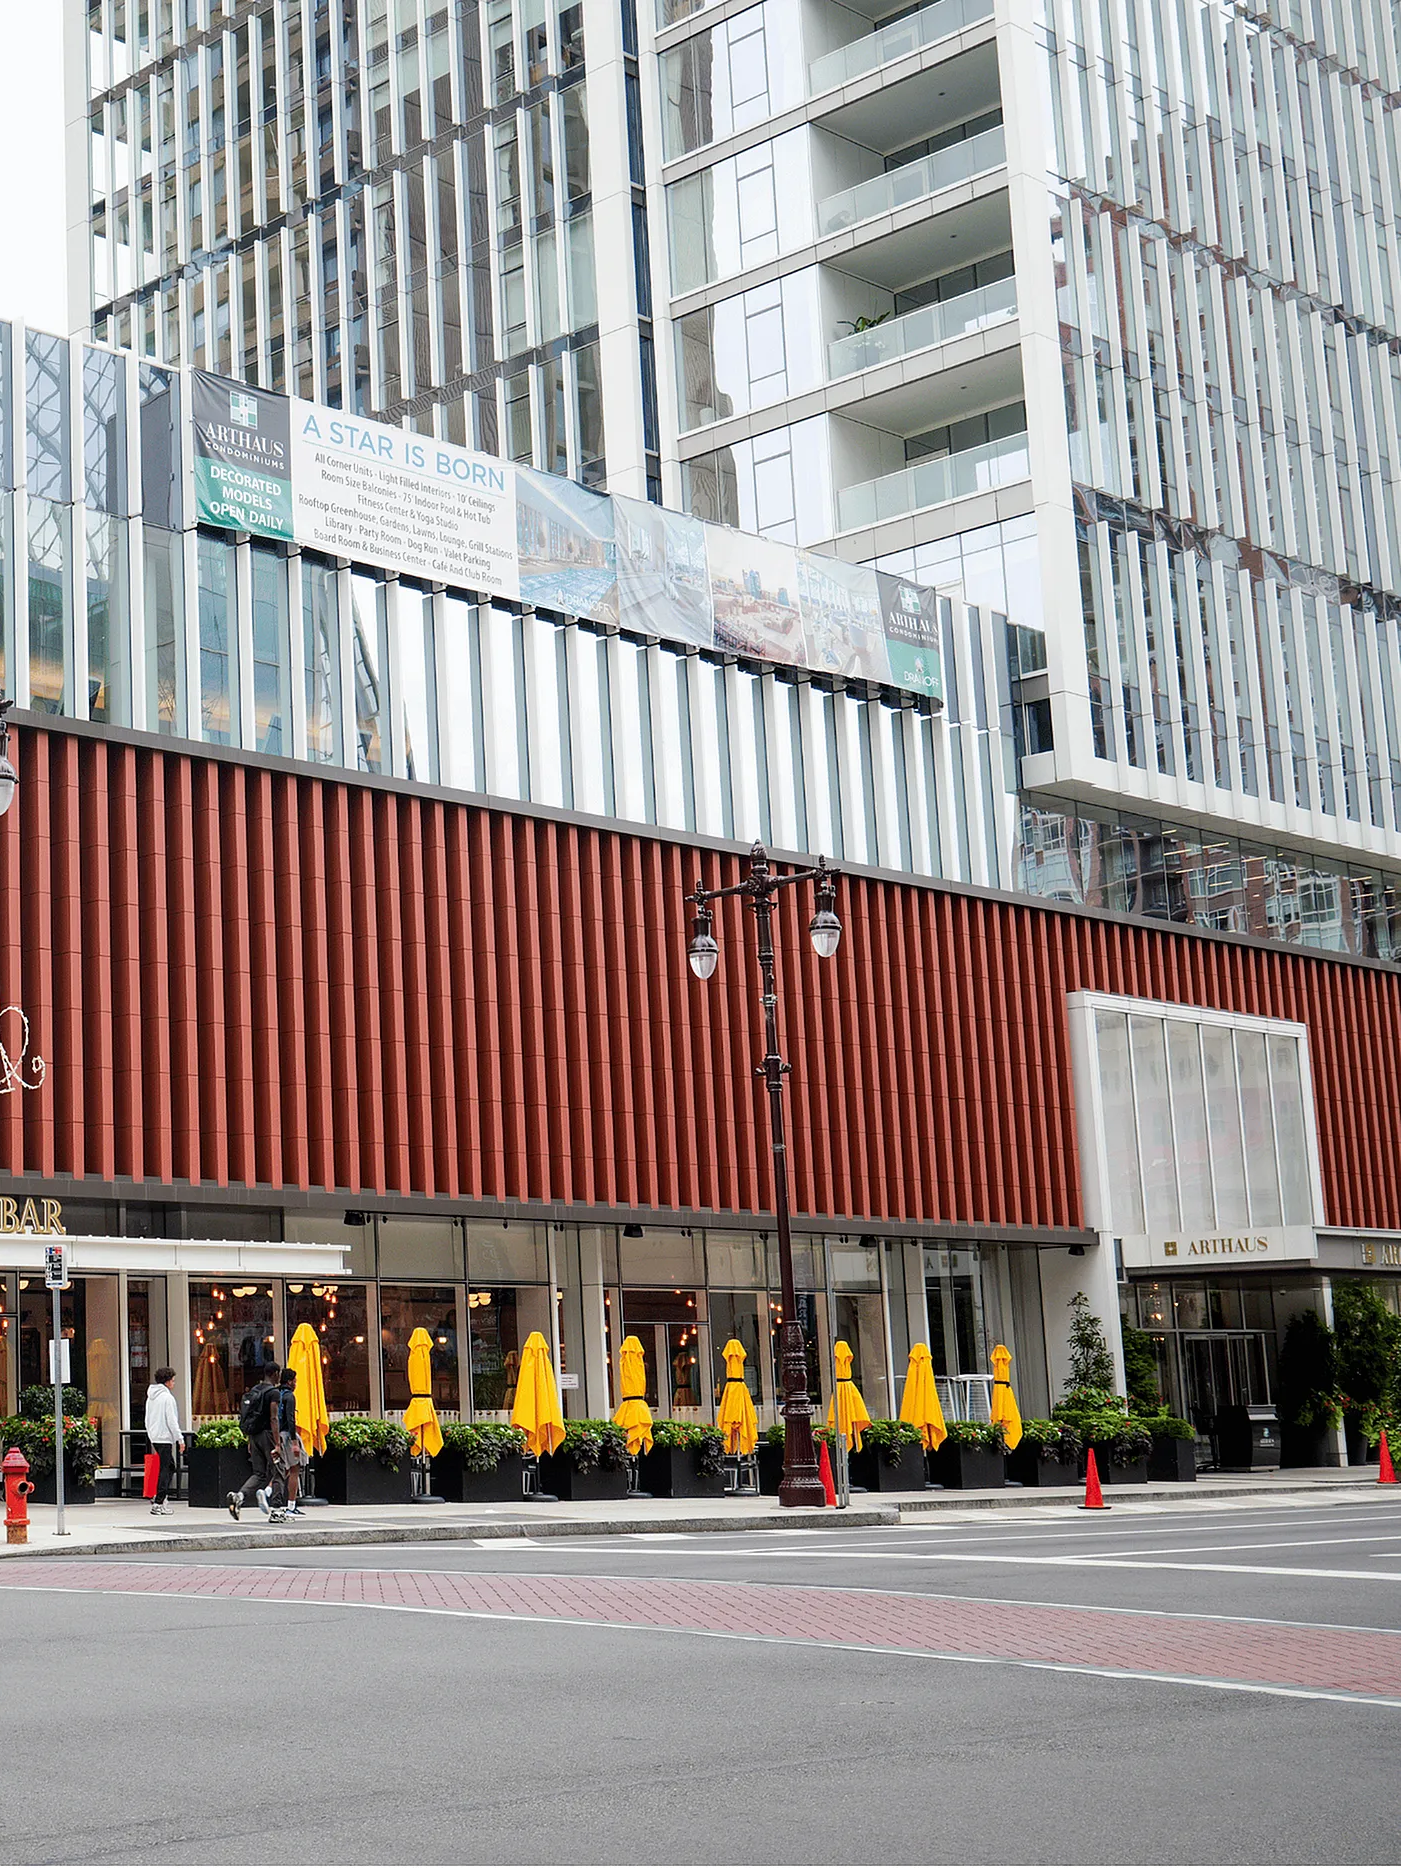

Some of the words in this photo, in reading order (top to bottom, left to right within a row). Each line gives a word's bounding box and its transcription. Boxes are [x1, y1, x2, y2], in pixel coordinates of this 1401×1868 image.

[205, 441, 285, 470] CONDOMINIUMS
[206, 422, 284, 458] ARTHAUS
[302, 414, 322, 439] A
[330, 421, 393, 460] STAR
[405, 443, 425, 468] IS
[436, 452, 504, 492] BORN
[210, 466, 282, 496] DECORATED
[222, 486, 272, 511] MODELS
[314, 452, 326, 464] All
[326, 456, 352, 472] Corner
[354, 464, 373, 478] Units
[379, 470, 398, 486] Light
[400, 476, 420, 491] Filled
[421, 481, 451, 500] Interiors
[468, 496, 496, 512] Ceilings
[322, 470, 344, 486] Room
[346, 476, 361, 489] Size
[362, 480, 397, 500] Balconies
[415, 496, 438, 511] Indoor
[440, 503, 456, 516] Pool
[457, 507, 462, 518] &
[464, 510, 478, 521] Hot
[478, 513, 492, 524] Tub
[210, 502, 245, 521] OPEN
[250, 511, 284, 530] DAILY
[298, 494, 330, 513] Rooftop
[331, 503, 378, 525] Greenhouse,
[380, 516, 412, 534] Gardens,
[413, 524, 438, 542] Lawns,
[440, 532, 468, 549] Lounge,
[468, 540, 484, 552] Grill
[485, 544, 513, 560] Stations
[358, 494, 384, 510] Fitness
[385, 503, 409, 518] Center
[410, 508, 416, 519] &
[416, 510, 434, 525] Yoga
[436, 517, 458, 532] Studio
[314, 528, 336, 544] Board
[338, 535, 360, 550] Room
[362, 540, 368, 551] &
[370, 544, 401, 561] Business
[402, 552, 426, 566] Center
[432, 560, 448, 572] Café
[450, 564, 464, 576] And
[464, 568, 482, 582] Club
[482, 572, 502, 586] Room
[326, 517, 352, 535] Library
[359, 524, 379, 540] Party
[380, 531, 402, 546] Room
[408, 538, 422, 553] Dog
[424, 542, 438, 554] Run
[444, 547, 462, 562] Valet
[464, 552, 491, 570] Parking
[1188, 1236, 1269, 1256] ARTHAUS
[1380, 1244, 1401, 1265] AR
